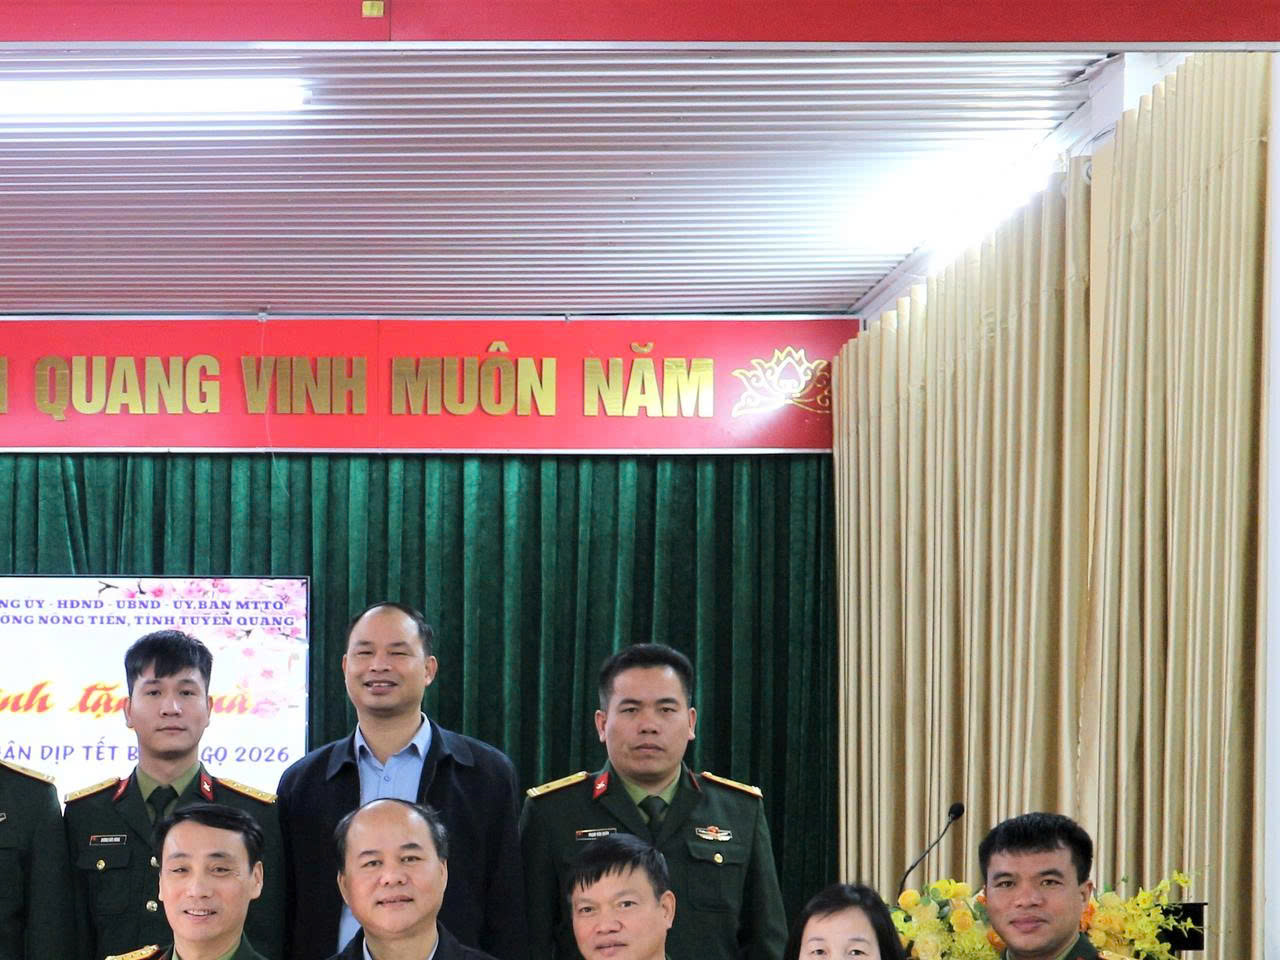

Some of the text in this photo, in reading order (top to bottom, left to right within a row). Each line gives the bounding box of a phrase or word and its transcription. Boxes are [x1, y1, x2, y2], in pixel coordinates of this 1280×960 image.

[34, 354, 220, 421] QUANG
[242, 356, 367, 414] VINH
[392, 341, 557, 416] MUÔN
[583, 342, 714, 417] NĂM
[116, 600, 161, 609] UBND
[237, 616, 295, 626] QUANG
[40, 745, 75, 765] DỊP
[82, 736, 119, 761] TẾT
[201, 746, 228, 766] GỌ
[235, 746, 290, 763] 2026
